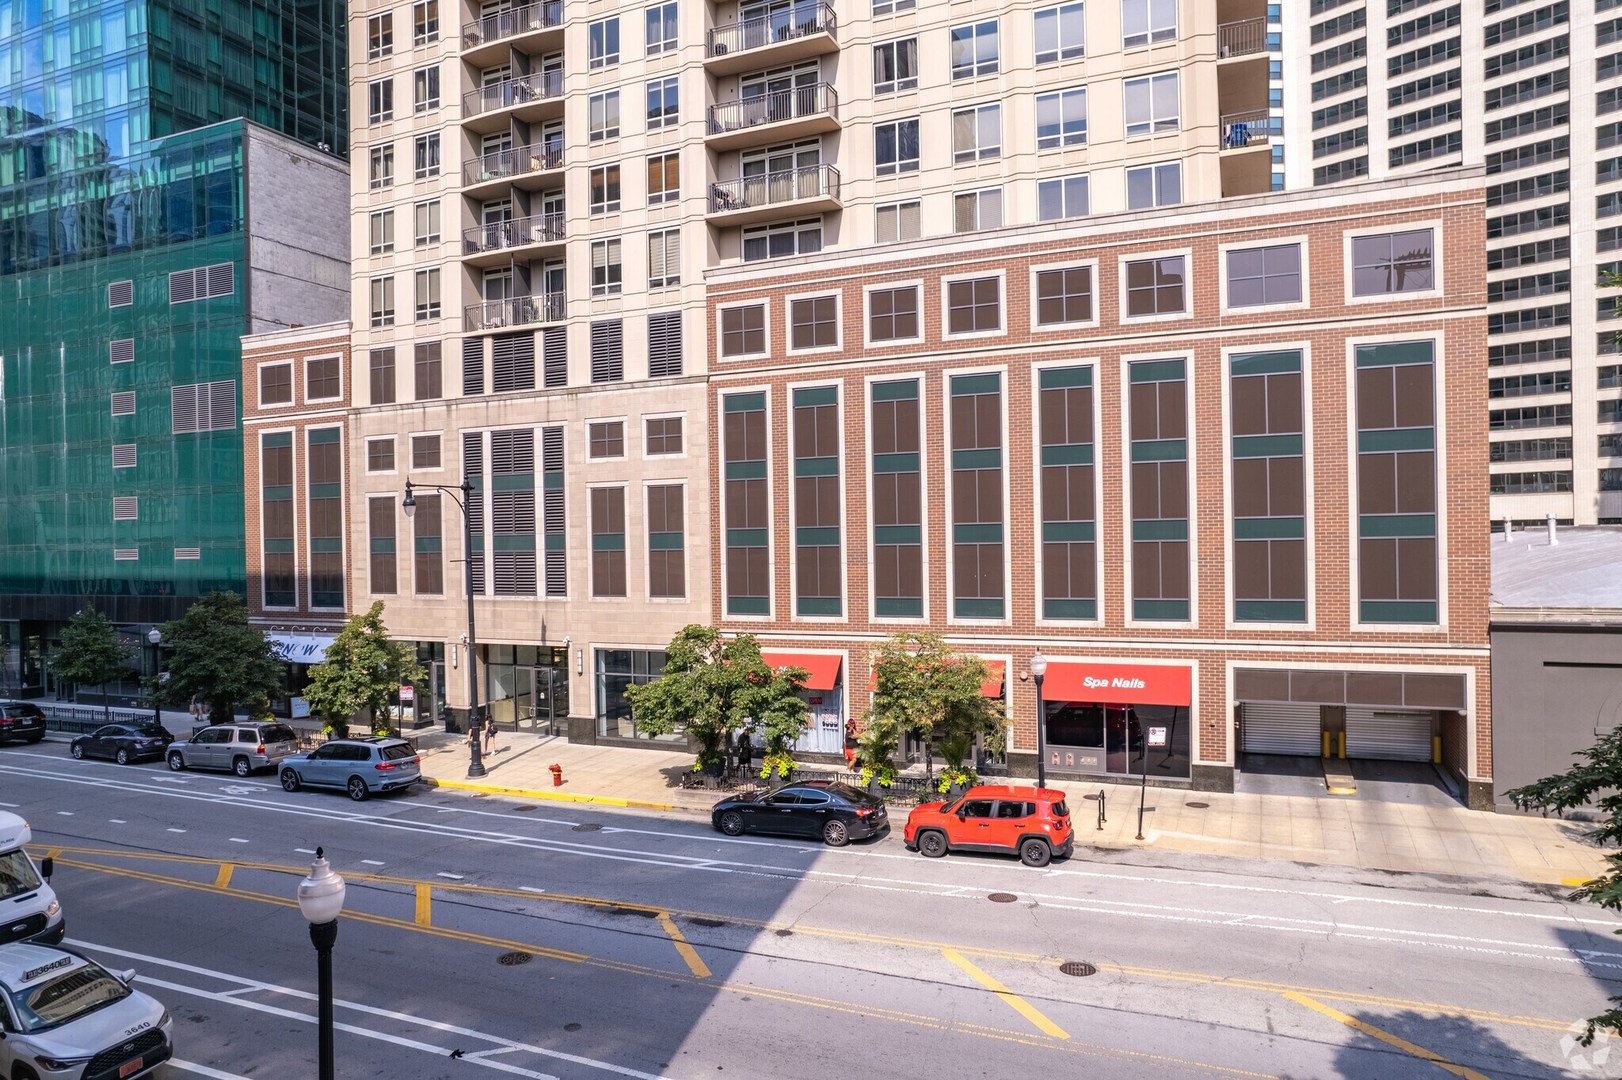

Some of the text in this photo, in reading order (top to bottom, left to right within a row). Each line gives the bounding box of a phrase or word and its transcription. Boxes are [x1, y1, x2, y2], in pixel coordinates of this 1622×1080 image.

[1083, 676, 1145, 688] Spa Nails
[37, 960, 60, 975] 3640
[124, 1021, 151, 1036] 3640
